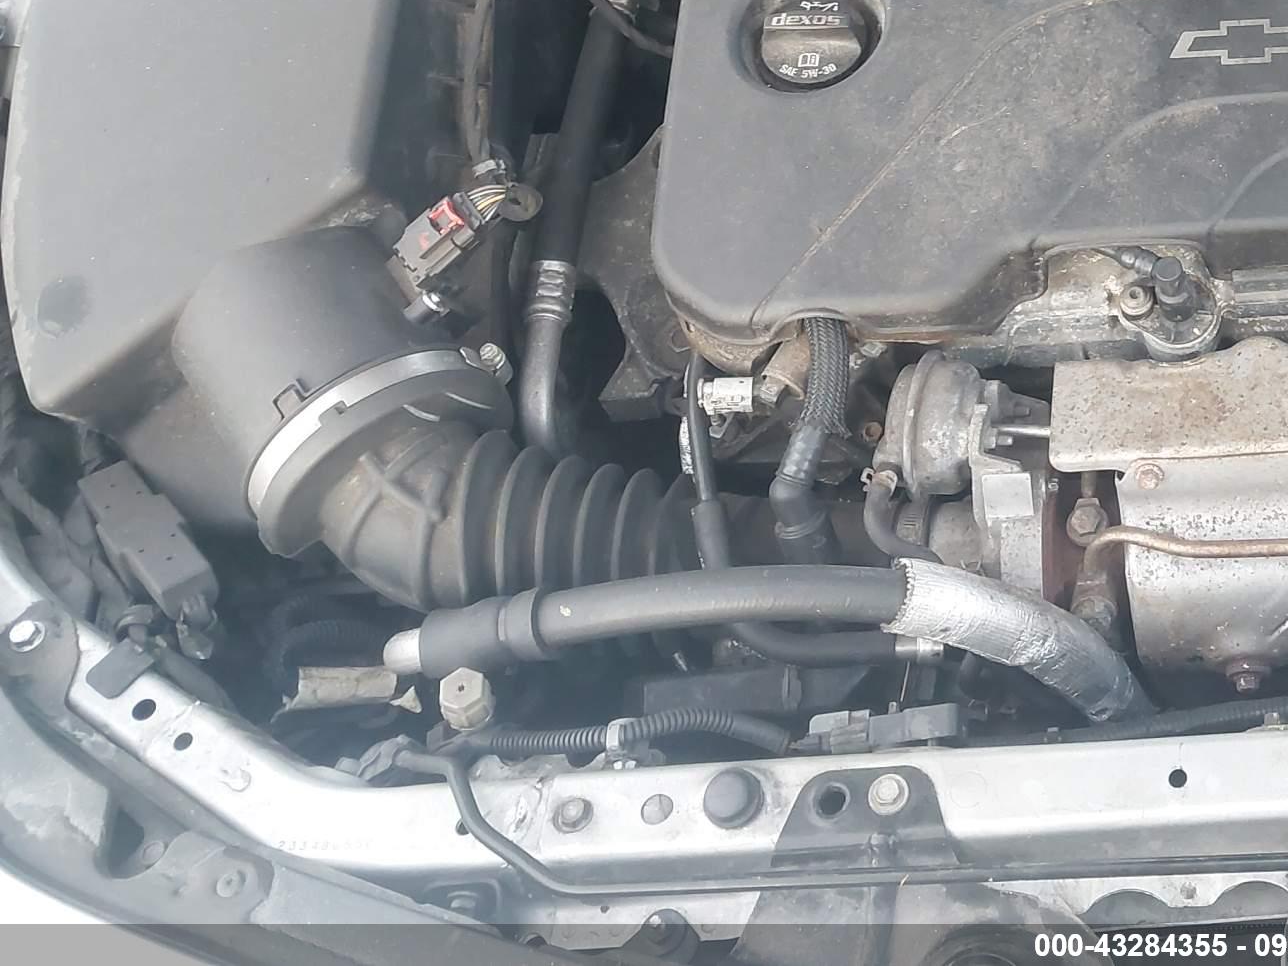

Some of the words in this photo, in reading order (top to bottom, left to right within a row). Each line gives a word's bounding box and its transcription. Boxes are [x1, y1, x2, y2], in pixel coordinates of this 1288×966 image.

[771, 12, 845, 26] dexos
[779, 64, 799, 77] SAE
[801, 63, 837, 78] 5W-30
